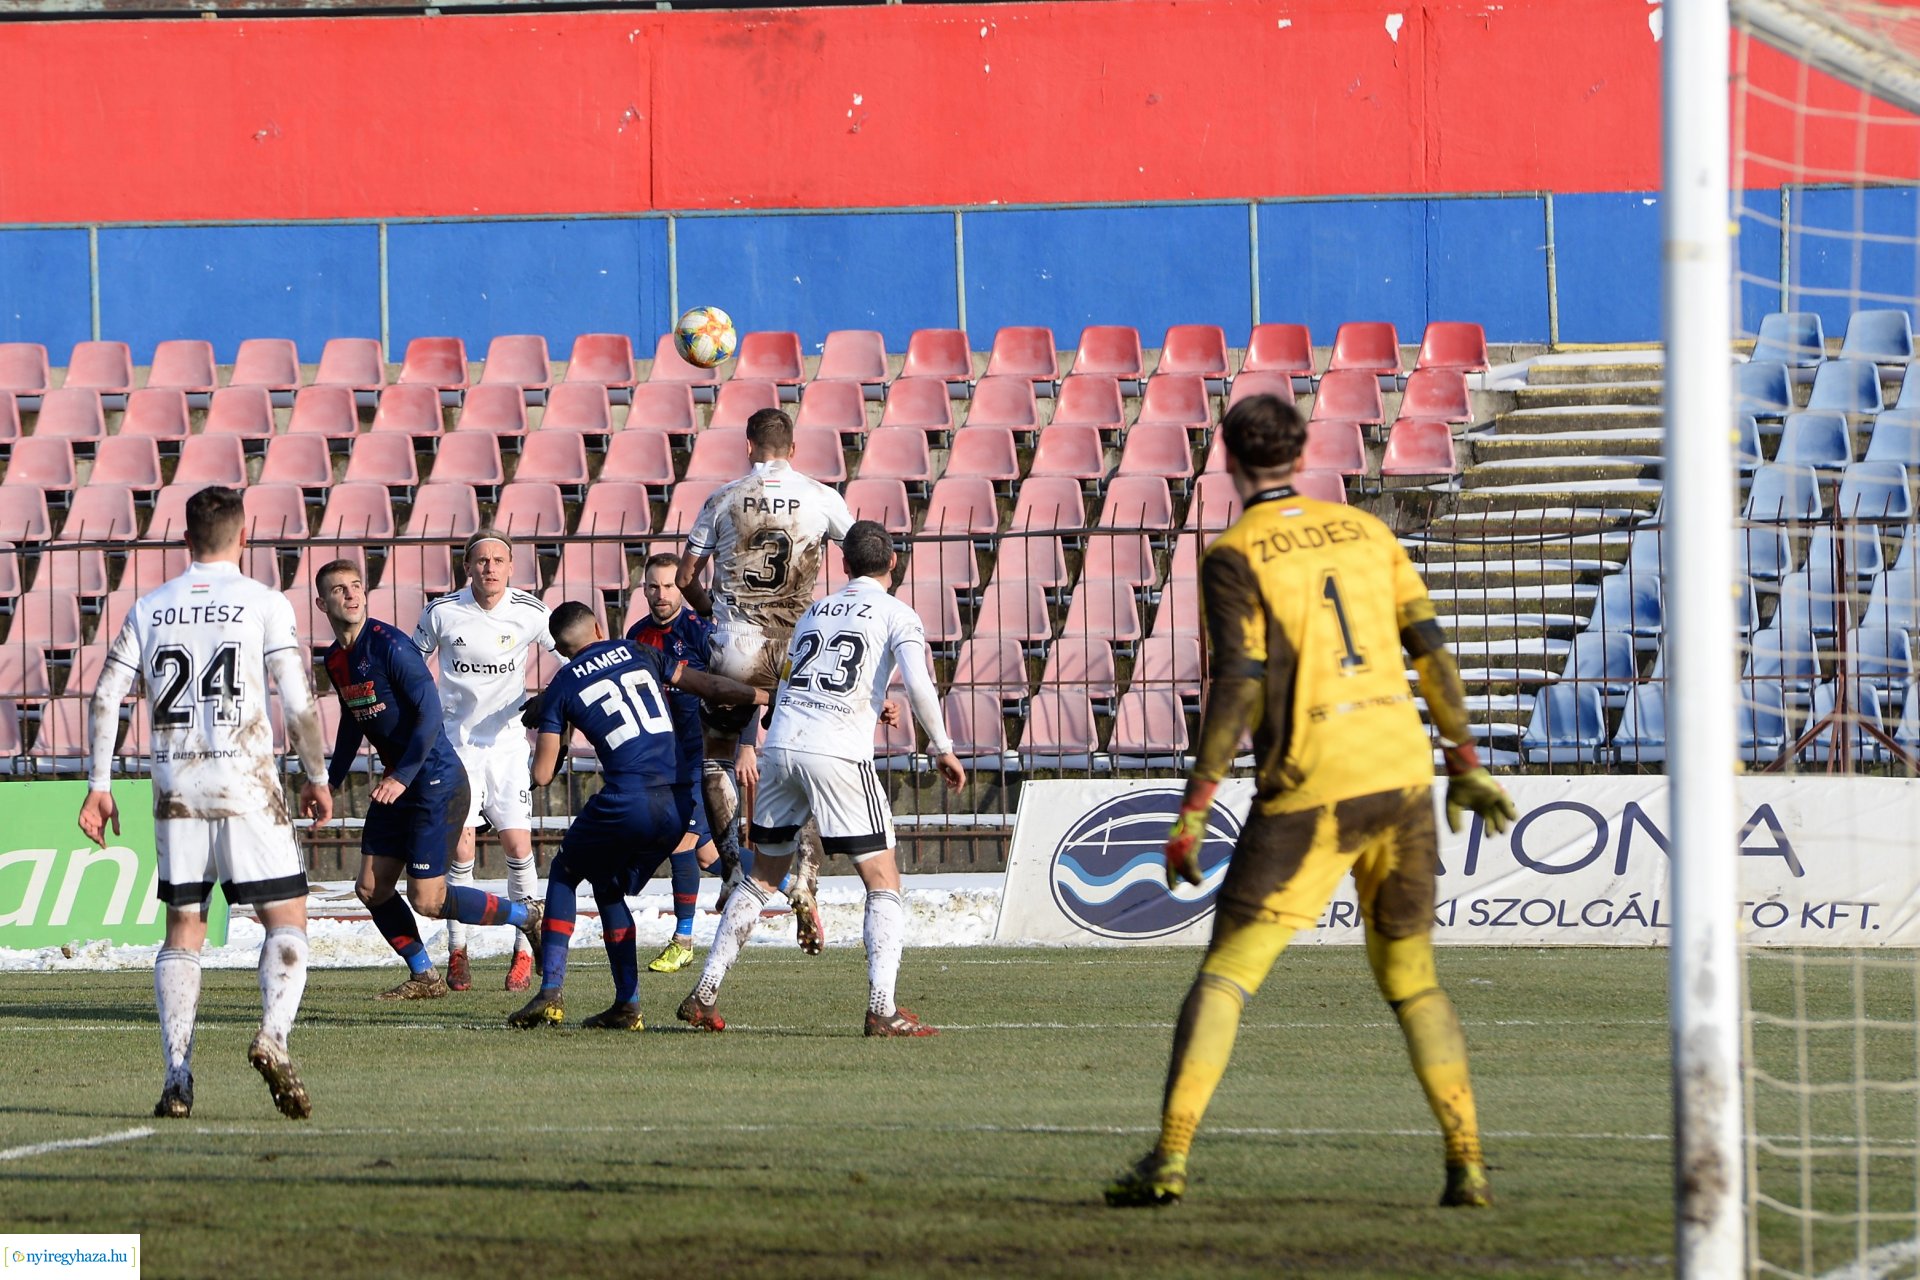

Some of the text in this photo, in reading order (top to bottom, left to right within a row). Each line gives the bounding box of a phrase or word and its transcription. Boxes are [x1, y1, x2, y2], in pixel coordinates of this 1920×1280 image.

[743, 497, 801, 515] PAPP
[743, 528, 793, 594] 3
[1252, 520, 1371, 563] ZÖLDESI
[152, 600, 245, 627] SOLTÉSZ
[807, 602, 873, 619] NAGY Z.
[1319, 568, 1373, 678] 1
[571, 645, 633, 679] HAMED
[786, 629, 870, 698] 23
[150, 641, 246, 731] 24
[578, 668, 674, 751] 30
[412, 862, 430, 870] JAKO
[1468, 892, 1789, 928] SZOLGÁLTÓ
[1800, 901, 1880, 930] KFT.
